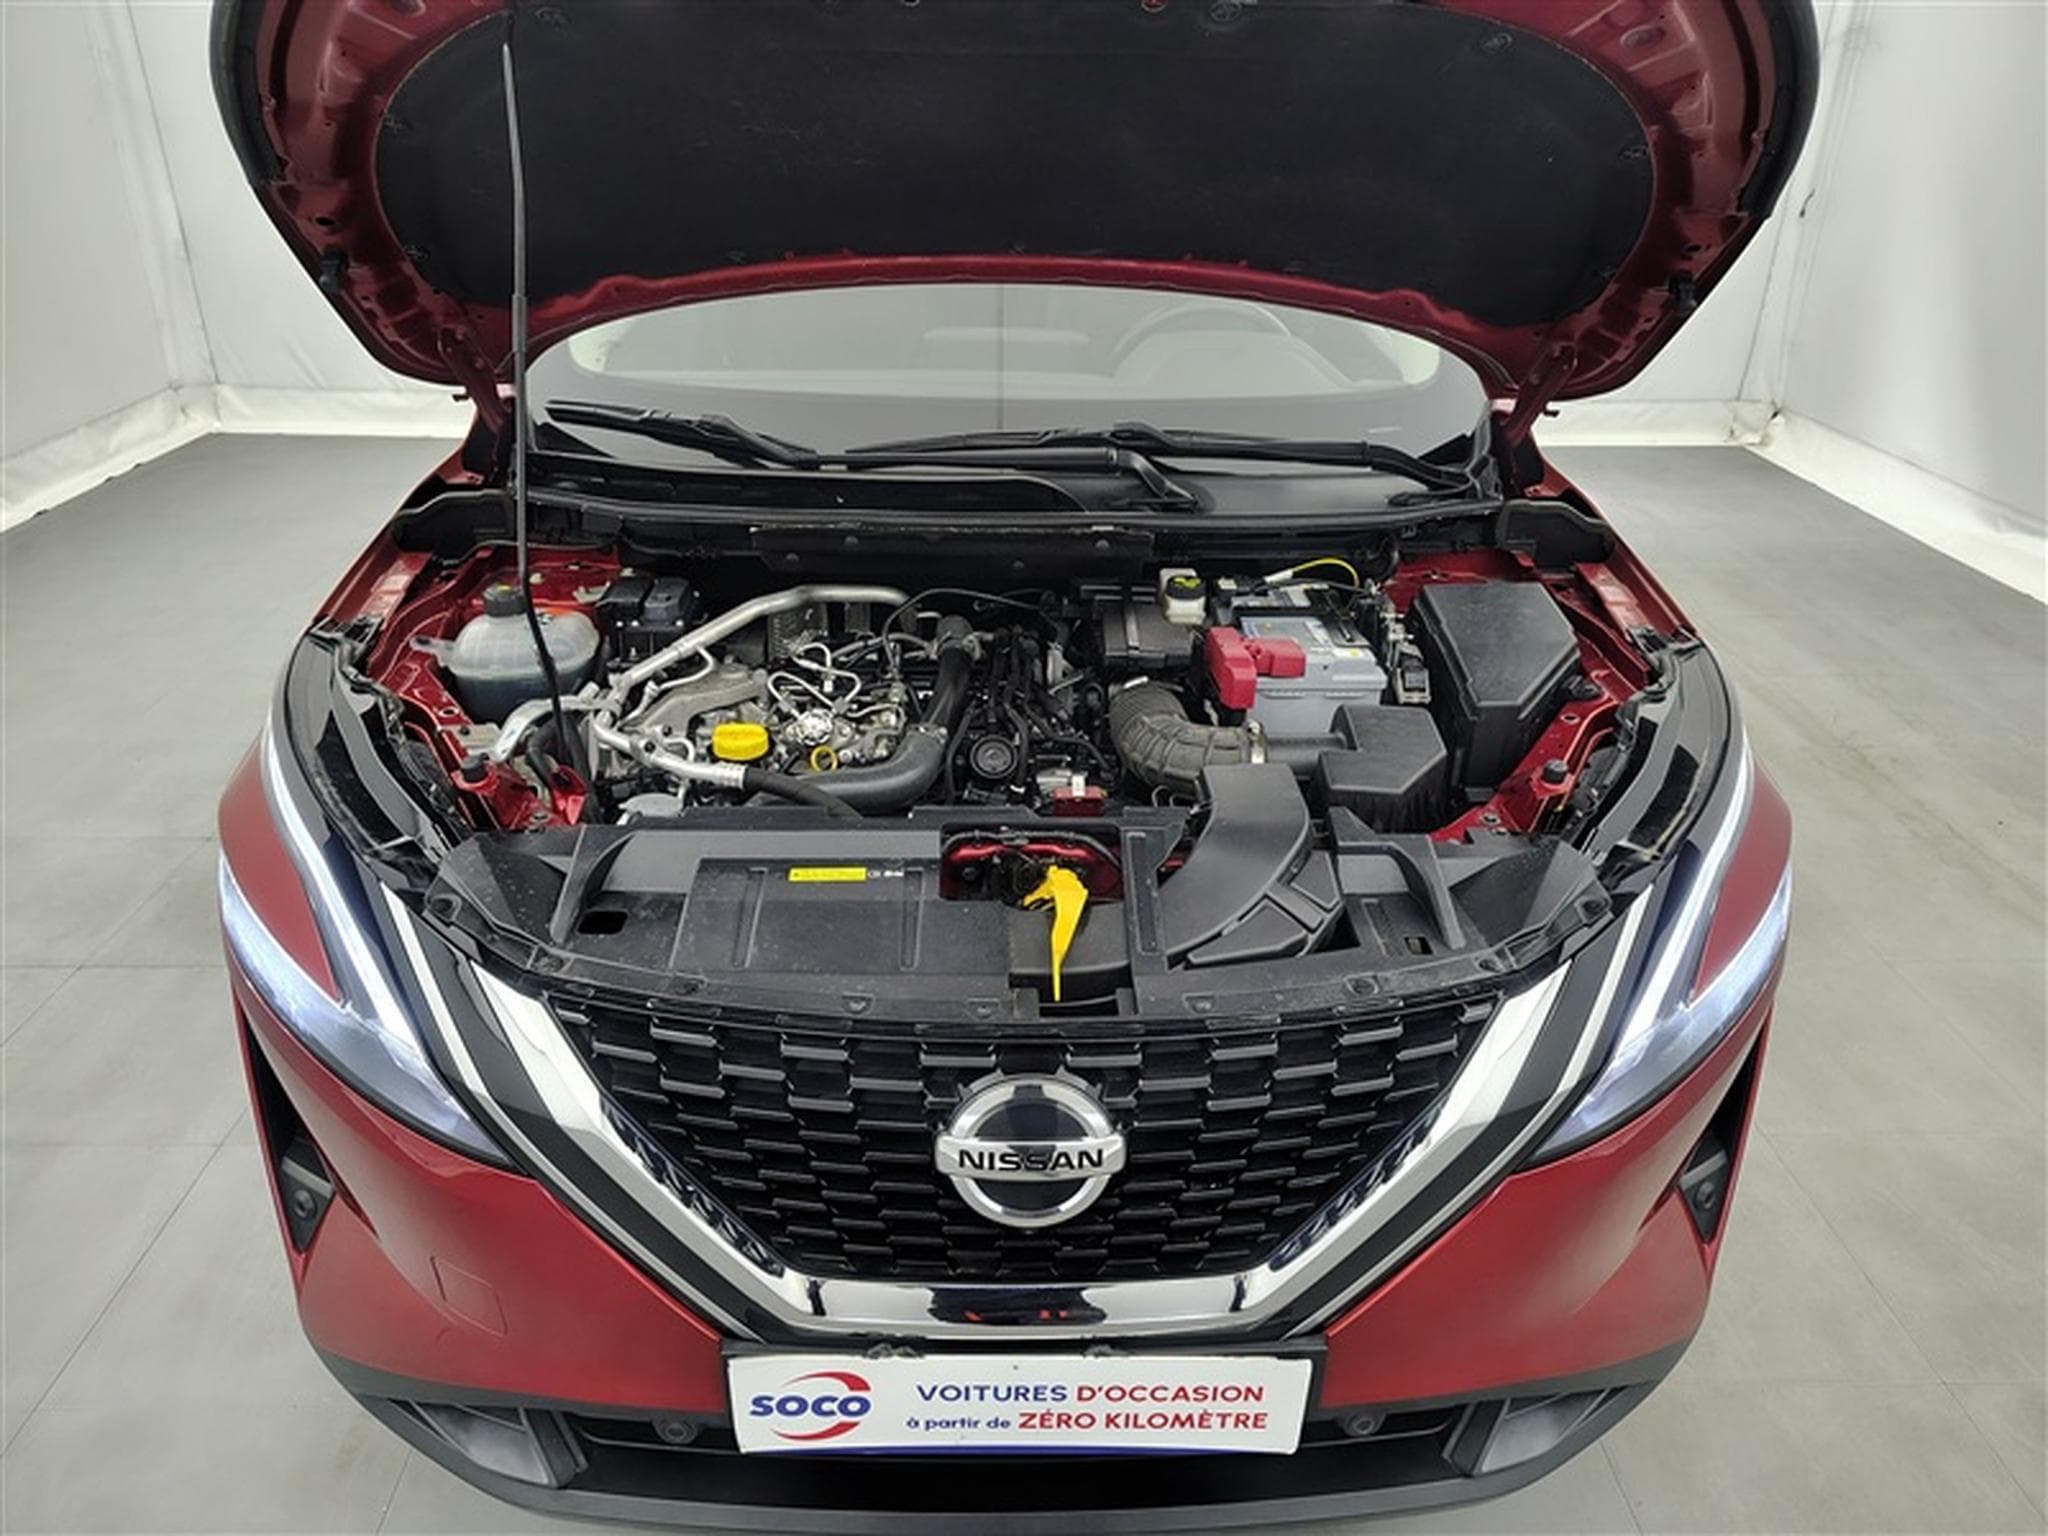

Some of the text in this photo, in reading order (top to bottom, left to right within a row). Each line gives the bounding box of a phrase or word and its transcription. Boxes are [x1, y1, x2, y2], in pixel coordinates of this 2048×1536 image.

[958, 1149, 1103, 1172] NISSAN
[916, 1384, 1265, 1402] VOITURES D'OCCASION
[750, 1395, 871, 1417] SOCO
[906, 1408, 1268, 1431] à partir de ZÉRO KILOMÈTRE
